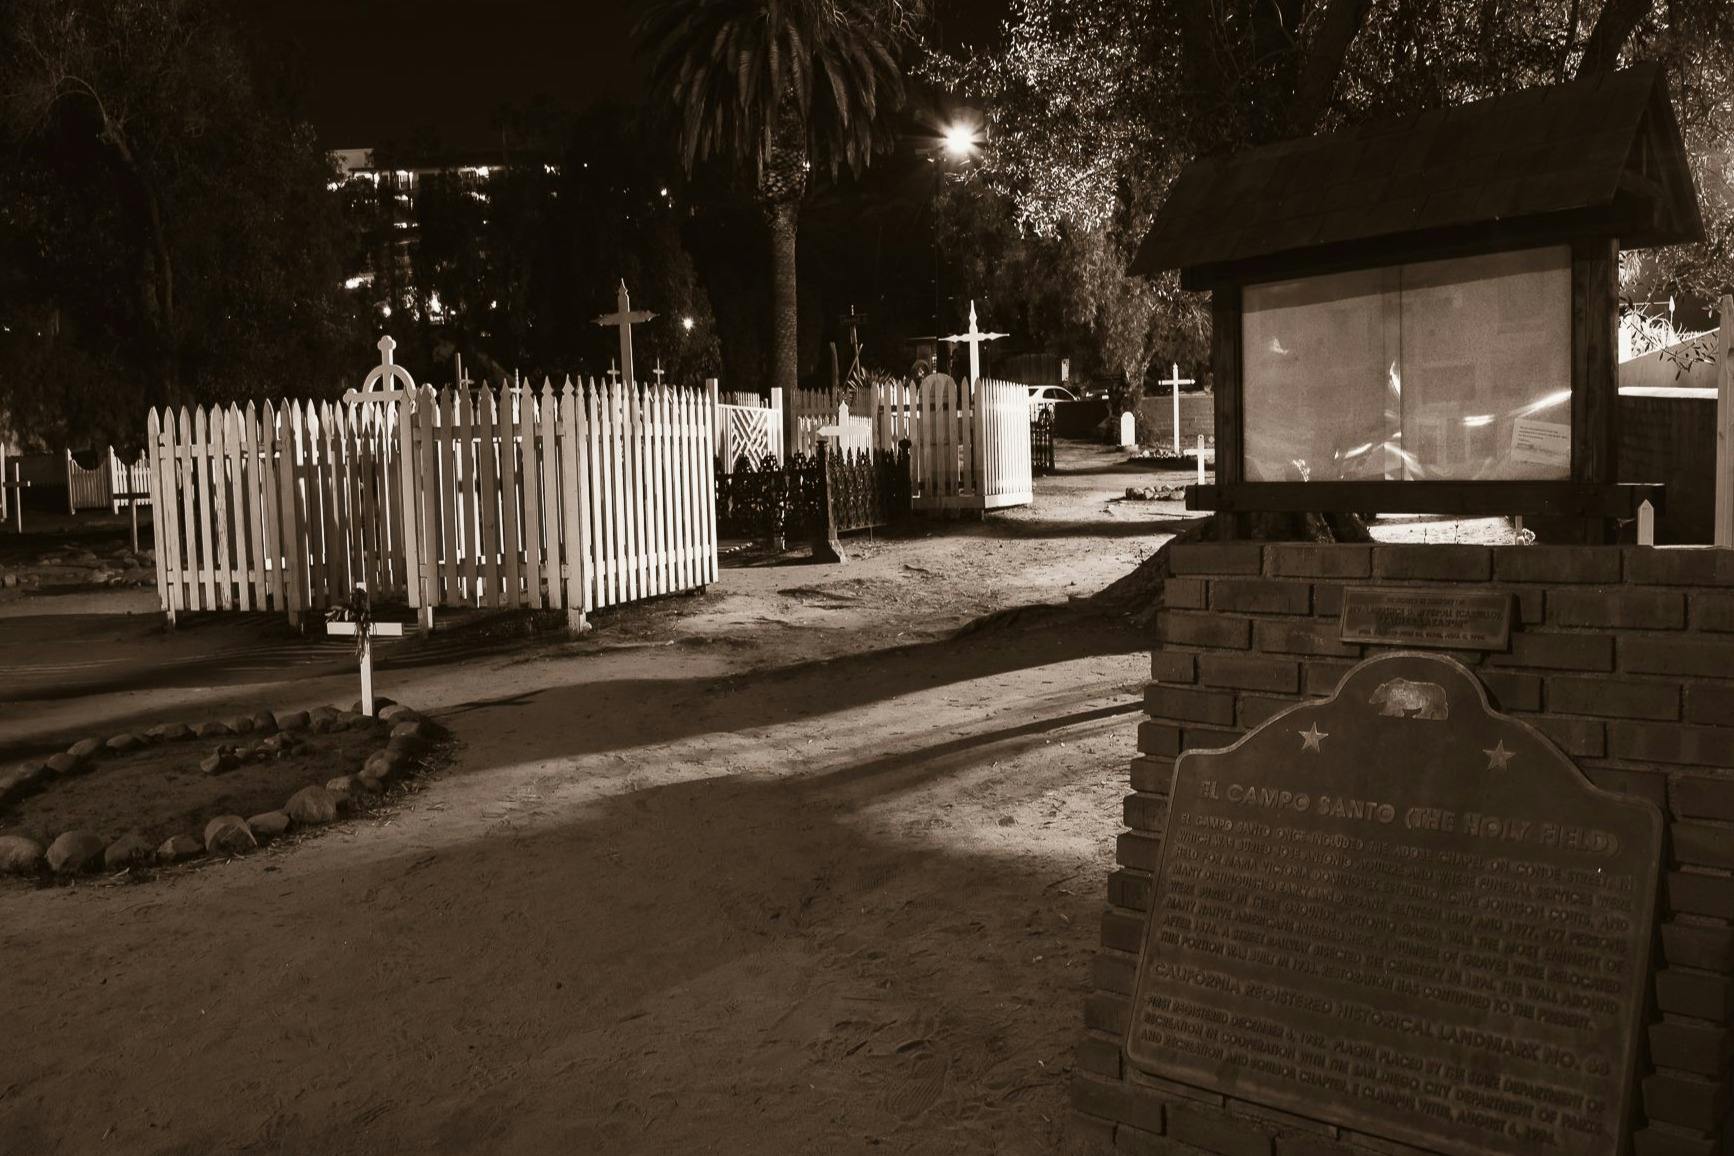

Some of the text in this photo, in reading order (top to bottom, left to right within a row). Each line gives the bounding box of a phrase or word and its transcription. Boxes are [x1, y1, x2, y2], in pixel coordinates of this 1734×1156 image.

[1181, 813, 1190, 824] EL
[1195, 815, 1232, 831] CAMPO
[1236, 821, 1270, 836] SANTO
[1275, 826, 1303, 841] ONCE
[1310, 831, 1364, 850] INCLUDED
[1368, 840, 1387, 854] THE
[1393, 843, 1434, 861] ADOBE
[1438, 850, 1483, 868] CHAPEL
[1490, 857, 1509, 872] ON
[1514, 861, 1561, 880] CONDE
[1615, 875, 1632, 890] IN
[1198, 780, 1620, 856] EL CAMPO SANTO (THE HOLY FIELD)
[1173, 863, 1201, 878] MANY
[1204, 868, 1276, 891] DISTINGUISHED
[1277, 881, 1305, 896] EARLY
[1392, 900, 1441, 919] BETWEEN
[1476, 914, 1502, 930] AND
[1569, 930, 1627, 951] PERSONS
[1176, 847, 1198, 860] HELD
[1202, 851, 1222, 864] FOR
[1225, 854, 1258, 870] MARIA
[1262, 860, 1309, 878] VICTORIA
[1479, 895, 1544, 917] JOHNSON
[1604, 915, 1629, 931] AND
[1178, 829, 1210, 844] WHICH
[1212, 834, 1233, 848] WAS
[1235, 838, 1272, 854] BURIED
[1305, 848, 1352, 866] ANTONIO
[1405, 864, 1434, 879] AND
[1439, 869, 1475, 886] WHERE
[1481, 875, 1531, 895] FUNERAL
[1536, 883, 1589, 904] SERVICES
[1597, 893, 1631, 910] WERE
[1163, 914, 1191, 930] AFTER
[1222, 925, 1230, 937] A
[1232, 927, 1265, 944] STREET
[1266, 934, 1308, 953] RAILWAY
[1313, 943, 1361, 963] BISECTED
[1367, 953, 1384, 967] THE
[1388, 957, 1444, 979] CEMETERY
[1447, 968, 1462, 983] IN
[1502, 979, 1523, 995] THE
[1527, 983, 1557, 1001] WALL
[1561, 990, 1619, 1014] AROUND
[1166, 897, 1195, 913] MANY
[1198, 903, 1231, 920] NATIVE
[1234, 910, 1294, 931] AMERICANS
[1297, 921, 1343, 941] INTERRED
[1381, 937, 1389, 949] A
[1393, 939, 1440, 959] NUMBER
[1444, 948, 1458, 962] OF
[1465, 952, 1508, 972] GRAVES
[1513, 961, 1544, 979] WERE
[1550, 968, 1621, 993] RELOCATED
[1169, 880, 1195, 895] WERE
[1202, 886, 1232, 902] BURIED
[1236, 892, 1247, 904] IN
[1344, 911, 1395, 931] ANTONIO
[1446, 929, 1472, 945] WAS
[1479, 935, 1499, 950] THE
[1505, 939, 1534, 956] MOST
[1544, 946, 1599, 968] EMINENT
[1605, 957, 1623, 972] OF
[1154, 961, 1241, 994] CALIFORNIA
[1245, 981, 1333, 1014] REGISTERED
[1337, 1000, 1434, 1036] HISTORICAL
[1438, 1022, 1538, 1059] LANDMARK
[1544, 1044, 1582, 1069] NO.
[1160, 931, 1179, 945] THIS
[1181, 935, 1224, 954] PORTION
[1226, 944, 1247, 959] WAS
[1250, 949, 1274, 964] BUILT
[1278, 954, 1289, 967] IN
[1321, 963, 1392, 988] RESTORATION
[1397, 978, 1422, 994] HAS
[1423, 983, 1490, 1008] CONTINUED
[1493, 997, 1510, 1012] TO
[1513, 1001, 1535, 1017] THE
[1140, 1030, 1162, 1045] AND
[1164, 1035, 1223, 1061] RECREATION
[1225, 1050, 1247, 1067] AND
[1352, 1082, 1359, 1095] E
[1456, 1107, 1506, 1132] AUGUST
[1144, 1013, 1203, 1037] RECREATION
[1205, 1027, 1217, 1040] IN
[1223, 1031, 1295, 1059] COOPERATION
[1299, 1049, 1325, 1067] WITH
[1330, 1057, 1349, 1072] THE
[1382, 1069, 1419, 1090] DIEGO
[1423, 1079, 1449, 1097] CITY
[1456, 1087, 1533, 1117] DEPARTMENT
[1539, 1107, 1556, 1123] OF
[1561, 1112, 1602, 1134] PARKS
[1146, 995, 1170, 1011] FIRST
[1172, 1001, 1228, 1024] REGISTERED
[1230, 1014, 1284, 1038] DECEMBER
[1335, 1038, 1376, 1059] PLAQUE
[1381, 1049, 1423, 1070] PLACED
[1426, 1059, 1441, 1074] BY
[1445, 1064, 1465, 1080] THE
[1469, 1069, 1500, 1088] STATE
[1503, 1077, 1583, 1108] DEPARTMENT
[1587, 1096, 1605, 1113] OF
